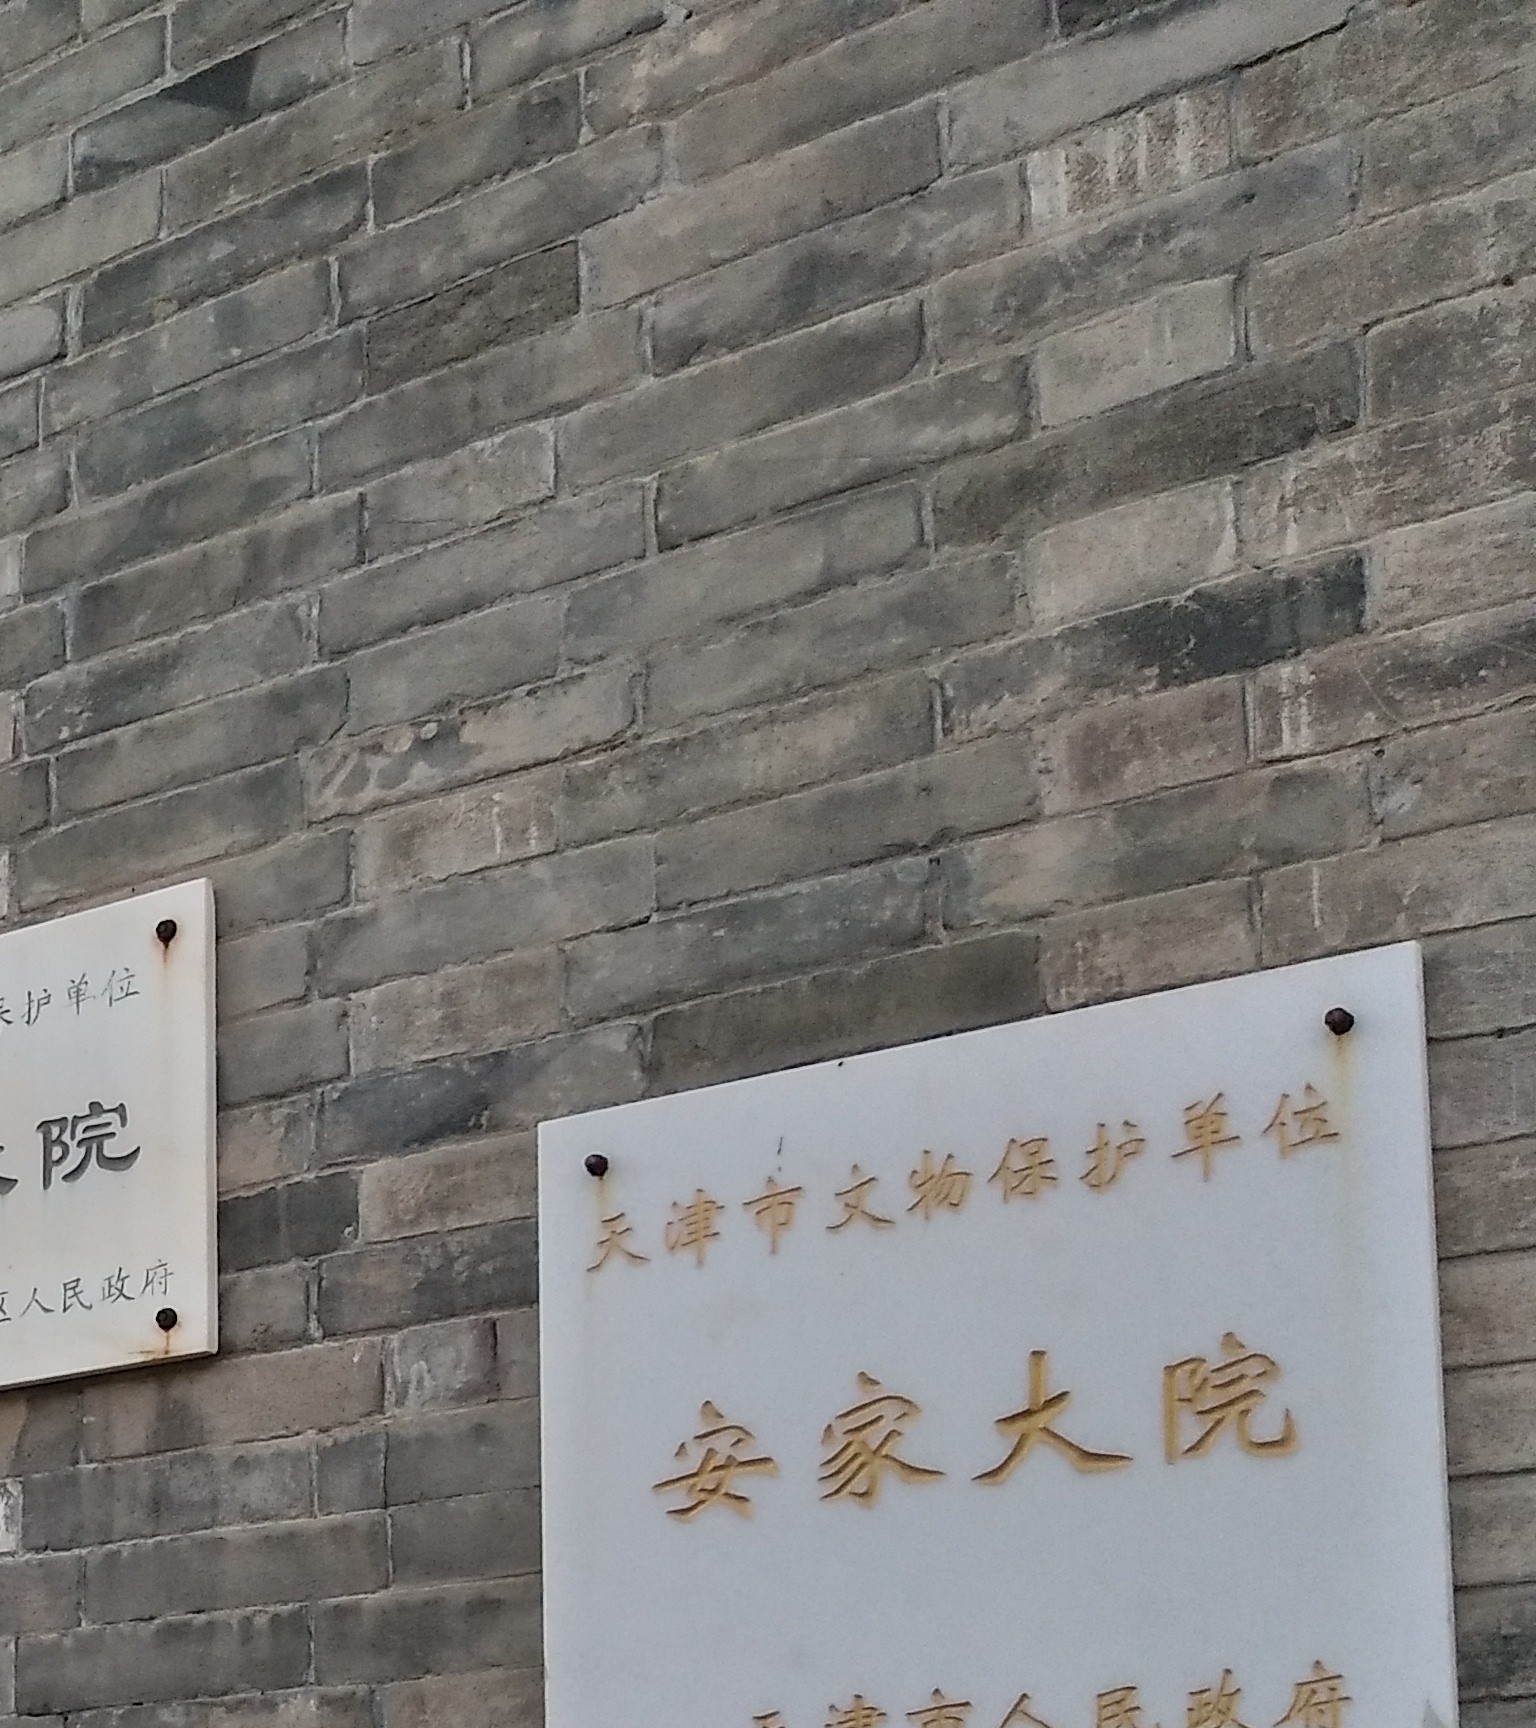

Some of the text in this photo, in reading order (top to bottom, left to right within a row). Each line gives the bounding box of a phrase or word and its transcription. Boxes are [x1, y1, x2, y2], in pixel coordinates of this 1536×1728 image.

[586, 1082, 1342, 1275] 天津市文物保护单位
[653, 1332, 1301, 1523] 安家大院
